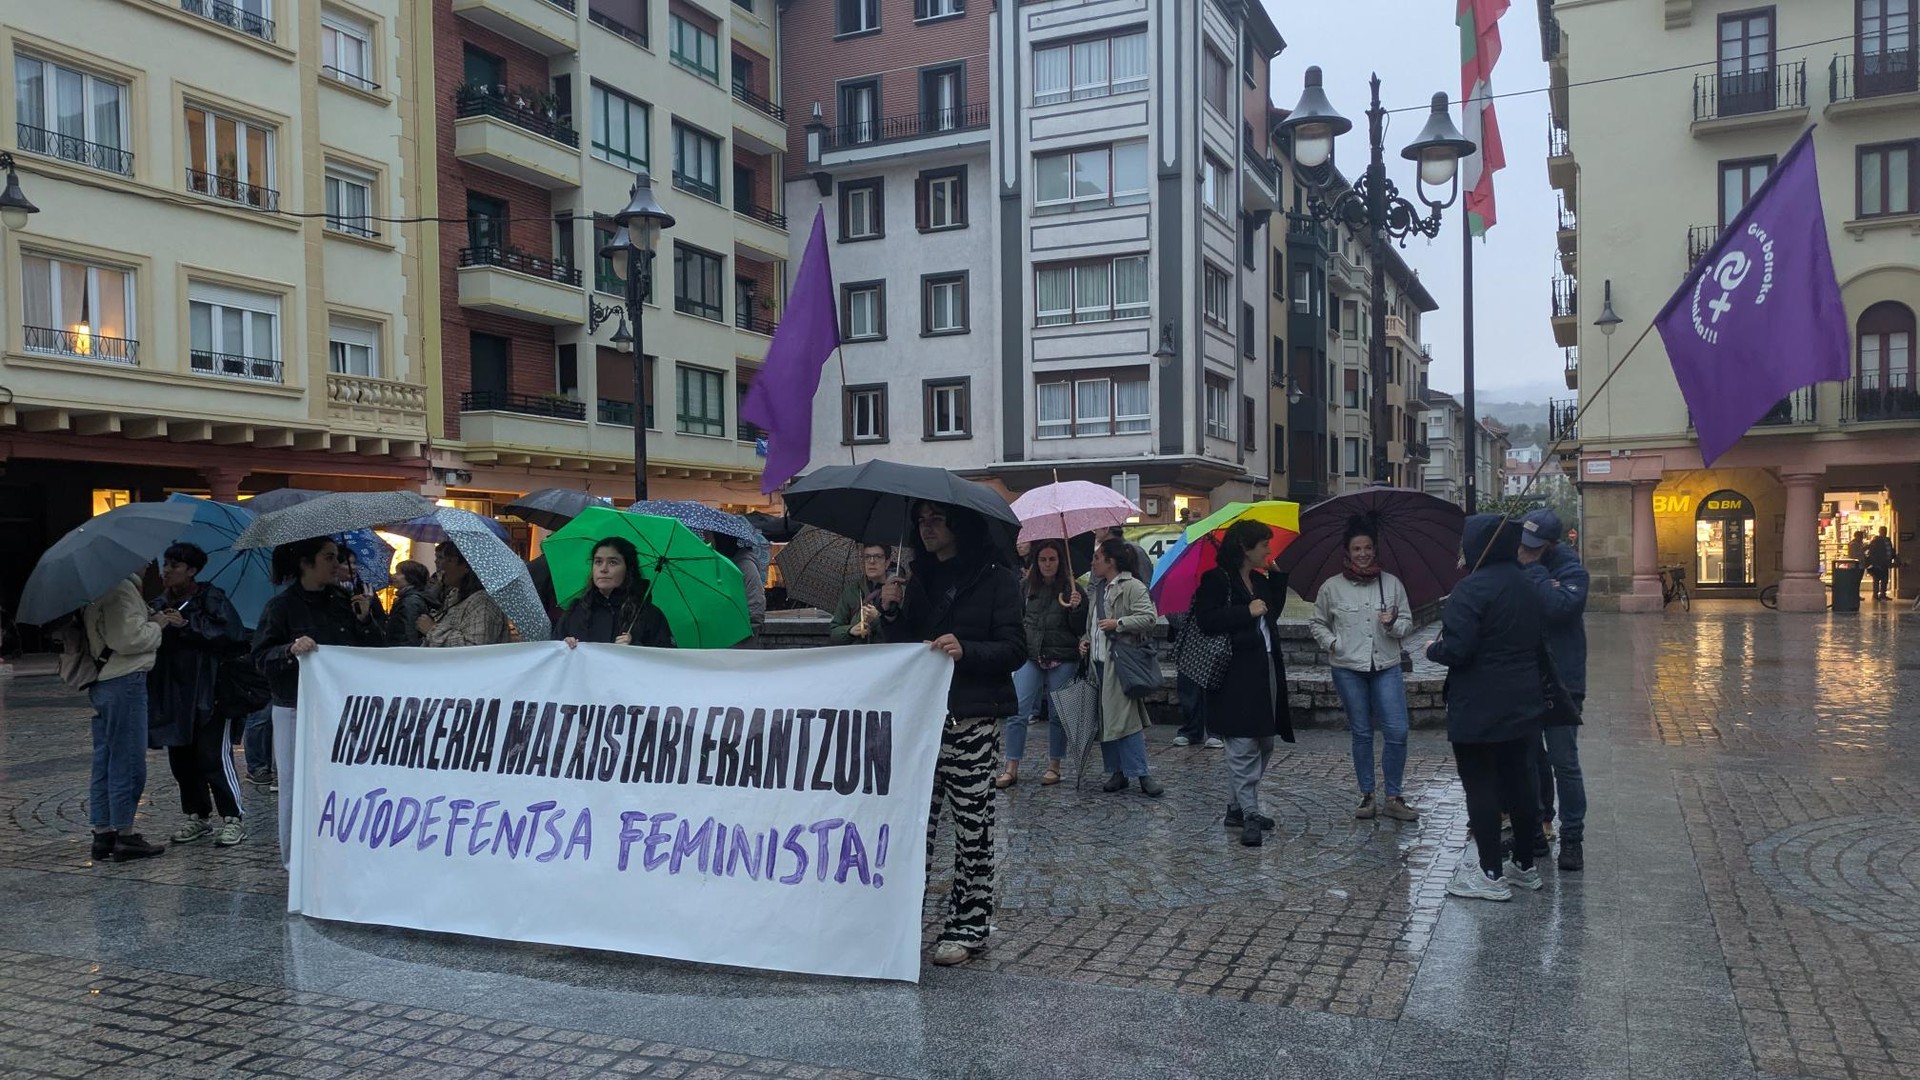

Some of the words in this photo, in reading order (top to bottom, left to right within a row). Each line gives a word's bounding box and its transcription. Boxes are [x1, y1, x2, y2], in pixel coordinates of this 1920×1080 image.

[1755, 239, 1774, 304] borroka
[1653, 495, 1690, 513] BM
[1720, 500, 1741, 509] BM
[331, 695, 501, 771] INDARKERIA
[497, 700, 698, 784] MATXISTARI
[697, 706, 892, 796] ERANTZUN
[318, 787, 592, 862] AUTODEFENTSA
[617, 811, 890, 889] FEMINISTA!
